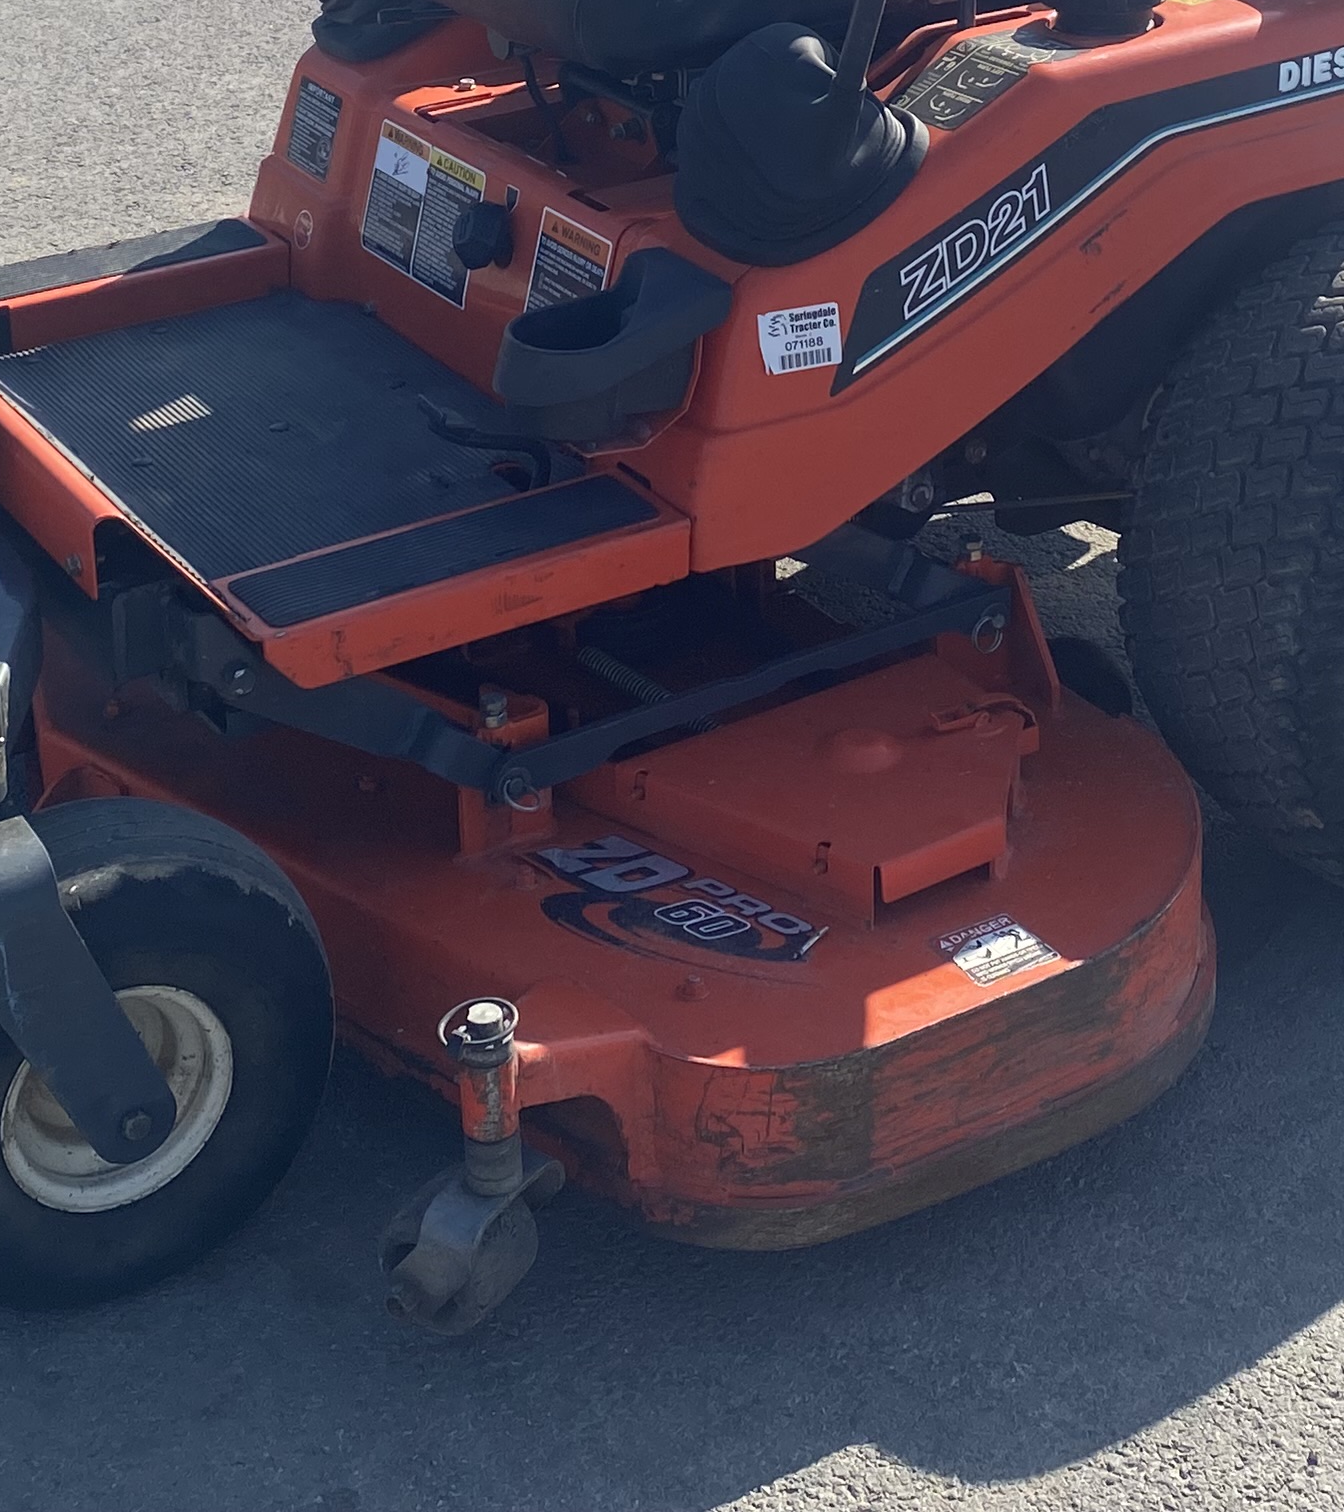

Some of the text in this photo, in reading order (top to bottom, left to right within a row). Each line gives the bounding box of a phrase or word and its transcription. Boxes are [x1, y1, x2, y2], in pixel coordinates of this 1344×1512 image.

[394, 127, 424, 156] WARNING
[444, 158, 477, 185] CAUTION
[561, 226, 601, 256] WARNING
[900, 163, 1051, 320] ZD21
[789, 307, 836, 322] Springdale
[823, 318, 836, 329] Co.
[785, 336, 824, 351] 071188
[536, 835, 690, 893] ZD
[653, 899, 751, 940] 60
[682, 877, 814, 935] PRO
[948, 916, 1012, 945] DANGER
